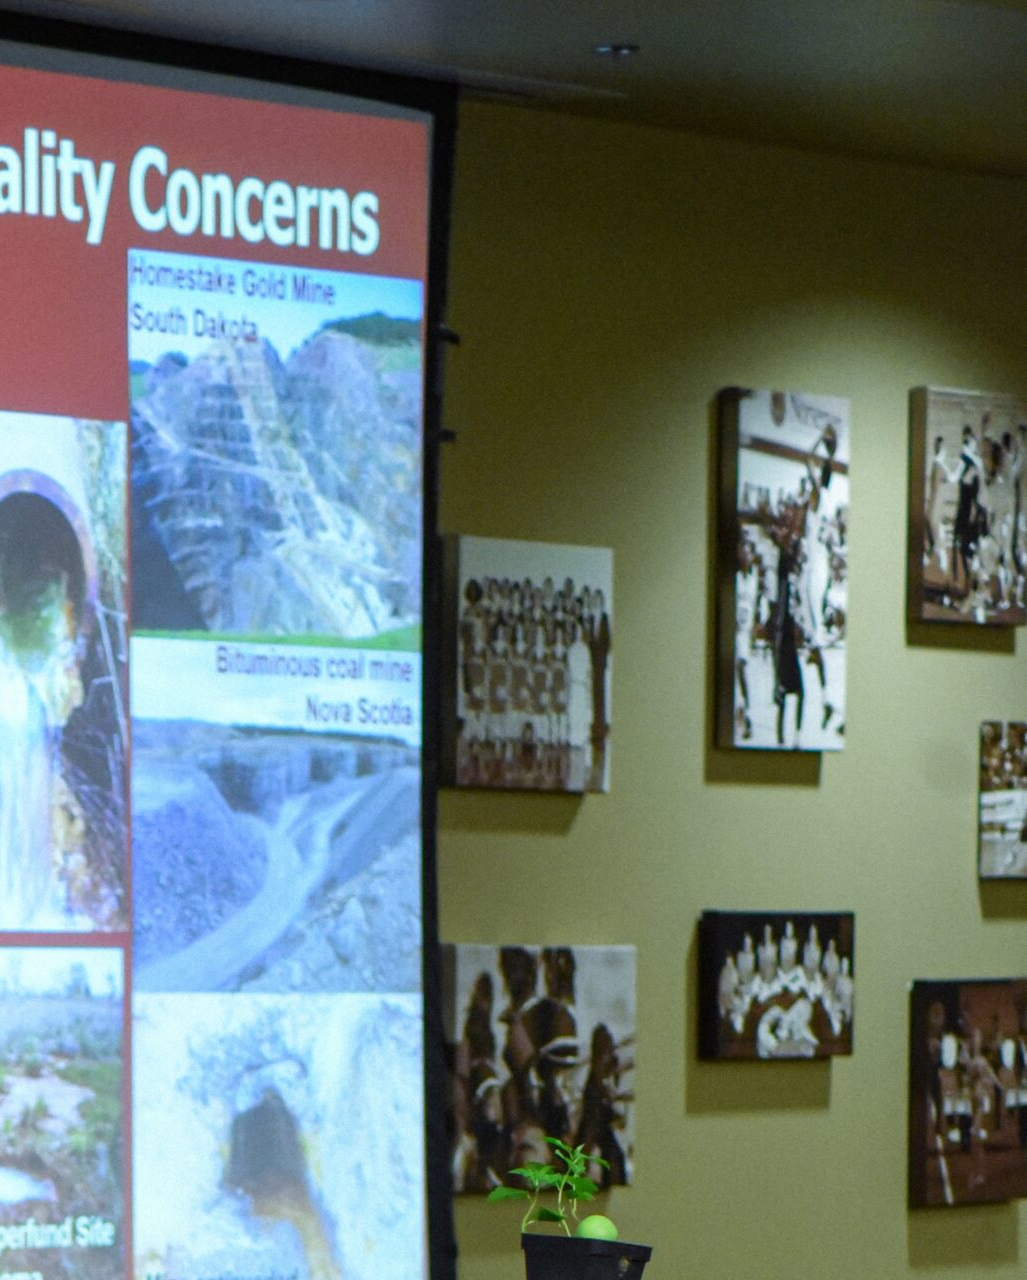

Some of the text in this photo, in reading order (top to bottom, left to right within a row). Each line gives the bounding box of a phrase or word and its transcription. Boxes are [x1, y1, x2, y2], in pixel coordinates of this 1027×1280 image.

[128, 145, 381, 256] Concerns
[129, 255, 335, 305] Homestake Gold Mine
[129, 302, 258, 342] South Dakota
[216, 645, 412, 682] Bituminous coal mine
[306, 692, 413, 726] Nova Scotia
[75, 1214, 116, 1248] Site
